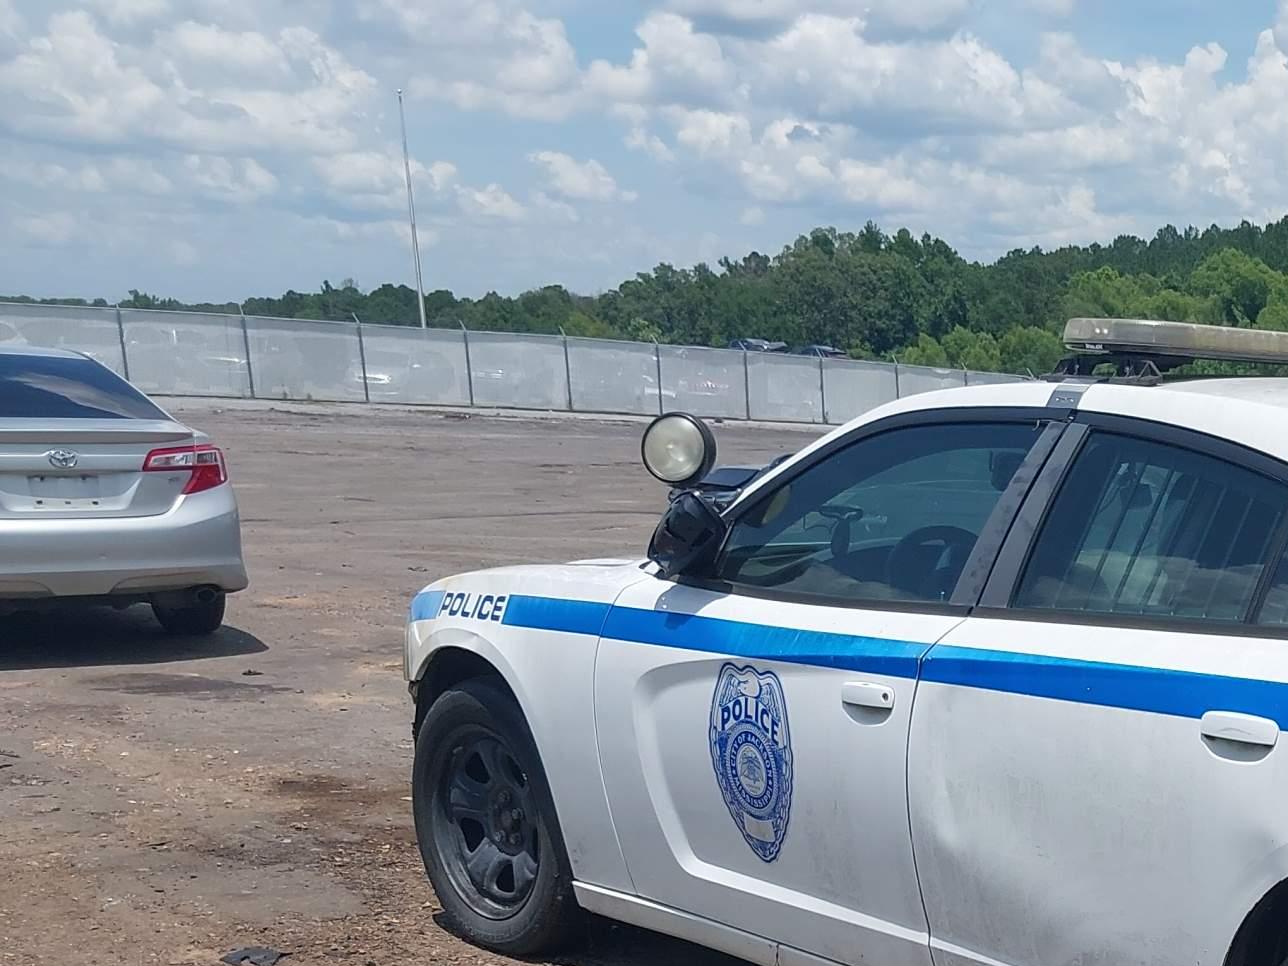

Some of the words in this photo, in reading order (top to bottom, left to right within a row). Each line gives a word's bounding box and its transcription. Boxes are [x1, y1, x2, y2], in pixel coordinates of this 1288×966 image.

[438, 592, 507, 622] POLICE
[721, 697, 780, 745] POLICE
[730, 741, 739, 767] CITY
[747, 733, 773, 777] JACKSON
[733, 777, 773, 808] MISSISSIPPI
